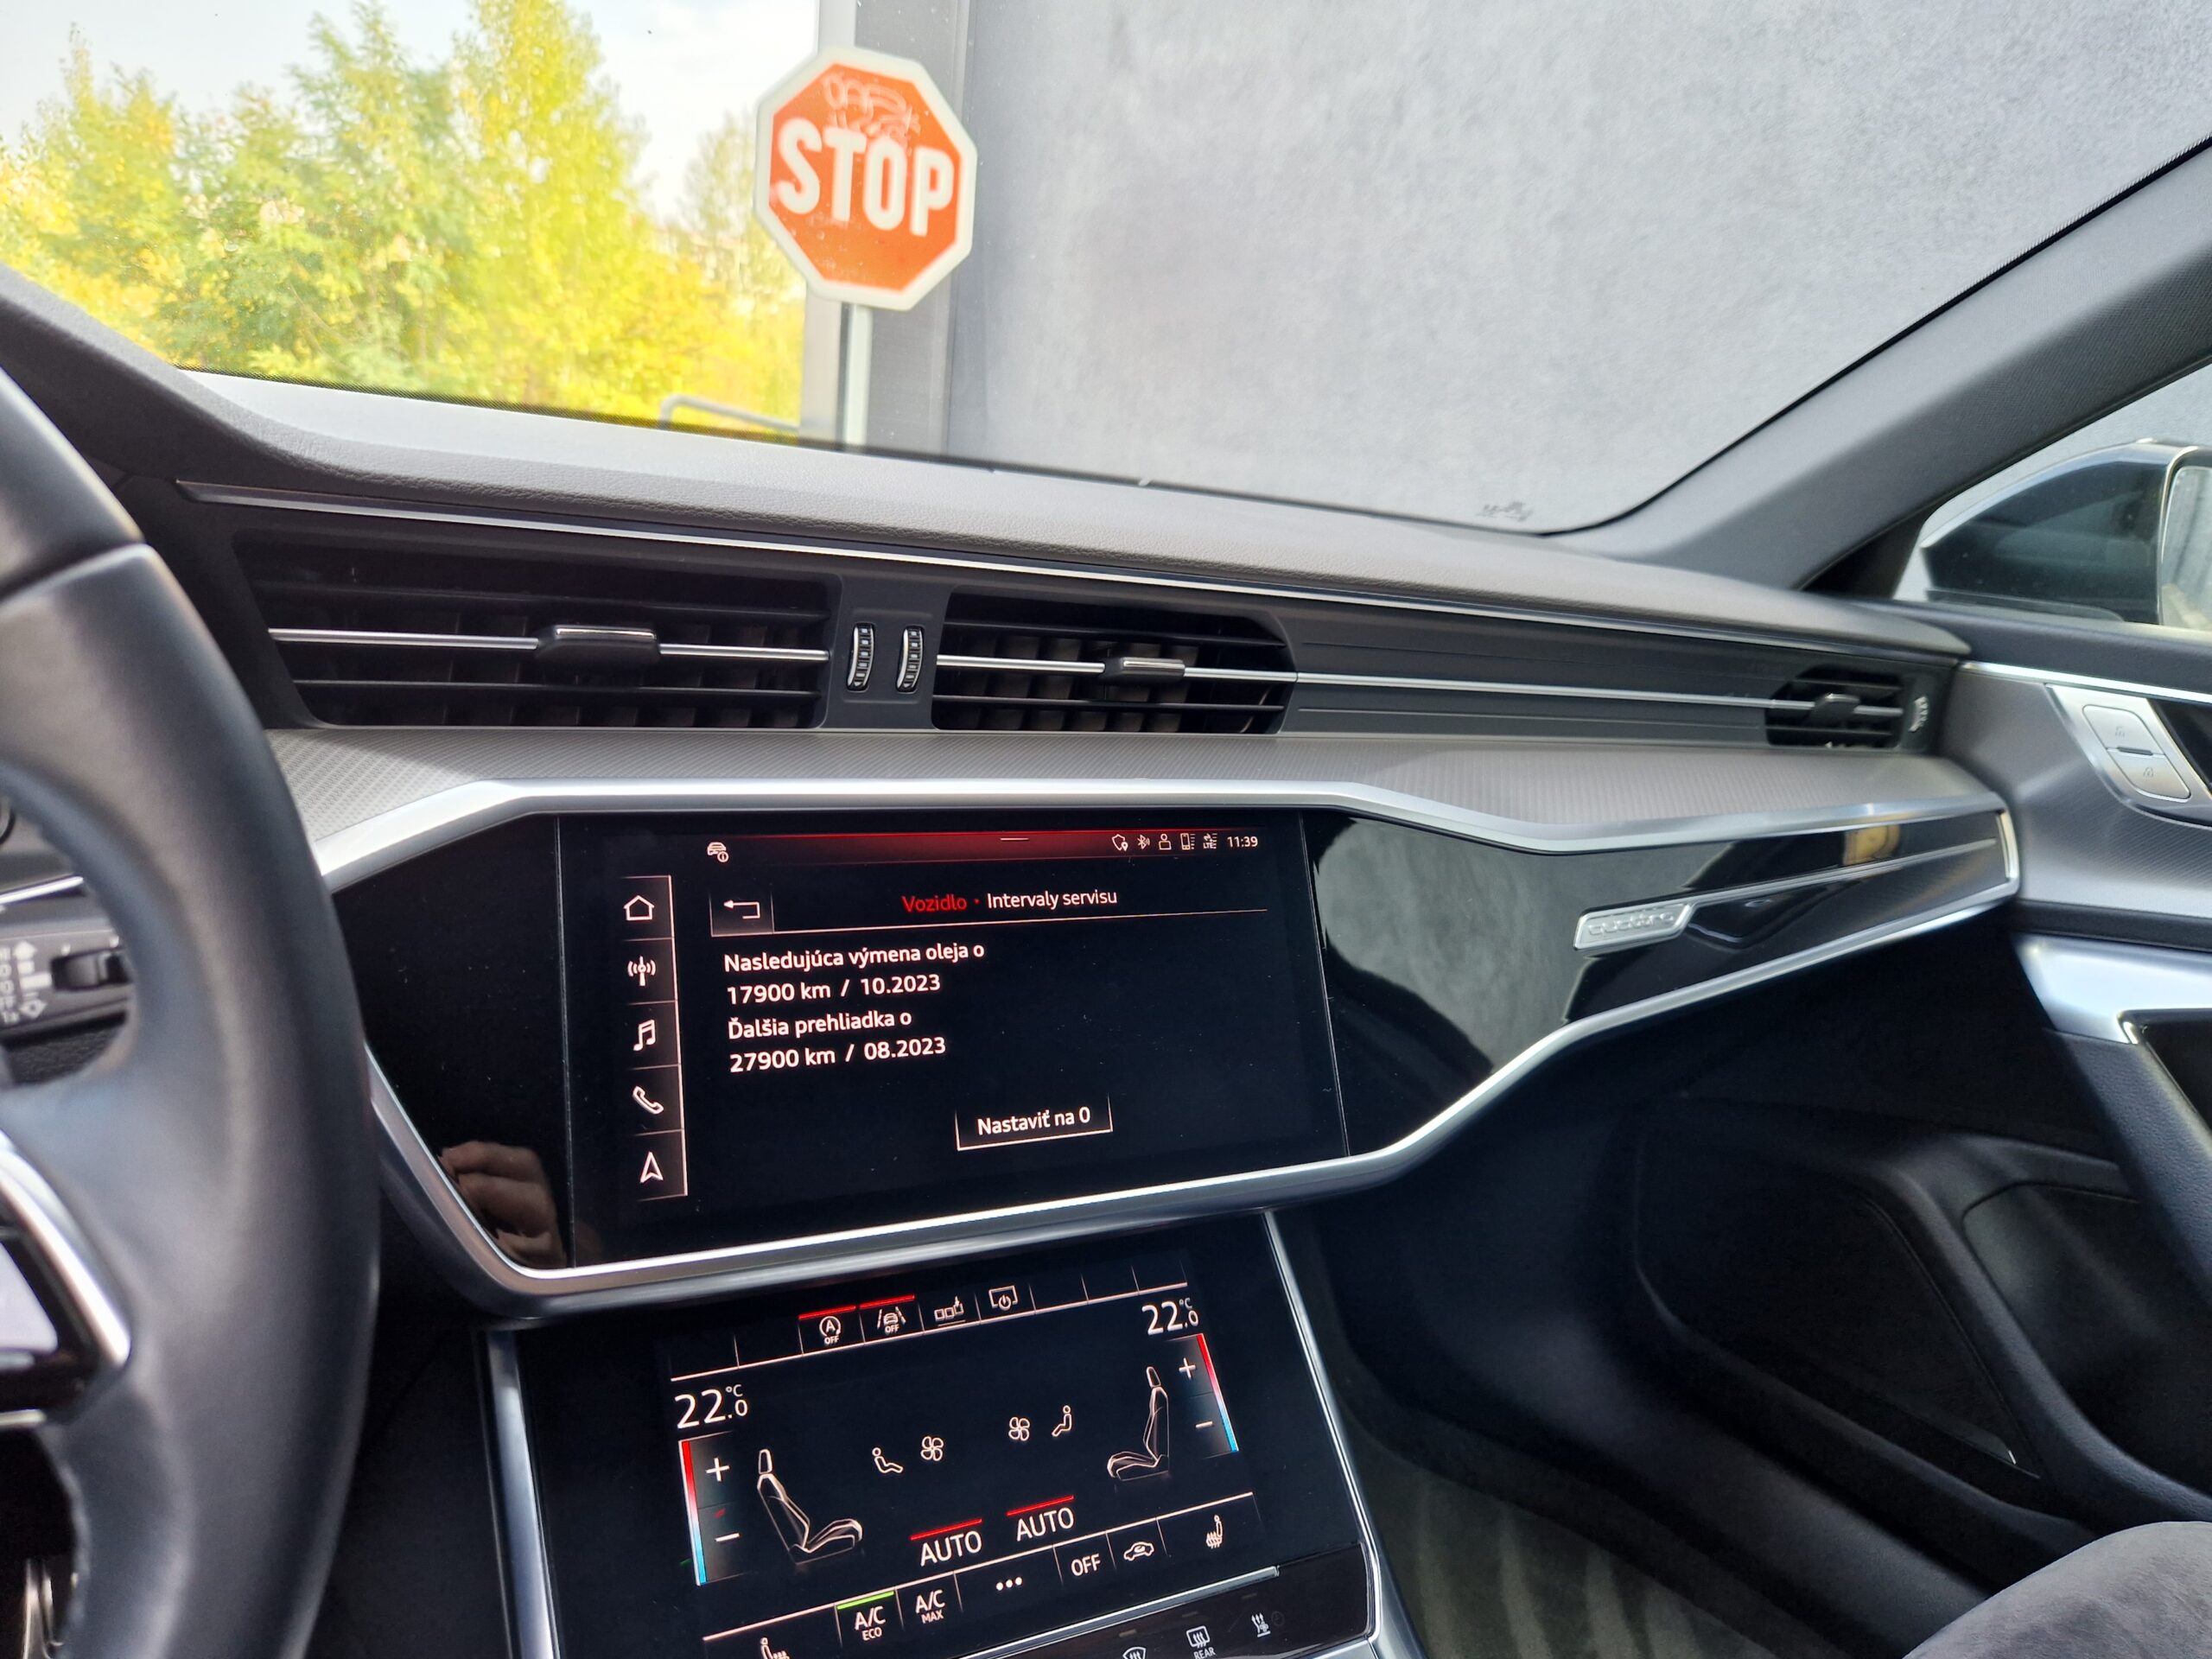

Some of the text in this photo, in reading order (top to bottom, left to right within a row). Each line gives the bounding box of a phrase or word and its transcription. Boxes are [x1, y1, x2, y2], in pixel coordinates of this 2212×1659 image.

[775, 116, 956, 238] STOP
[1227, 836, 1258, 848] 11:39
[902, 888, 1118, 913] Vozidlo Intervaly servisu
[724, 942, 985, 973] Nasledujúca výmena oleja o
[727, 973, 941, 1005] 17900 km / 10.2023
[728, 1010, 912, 1039] Ďalšia prehliadka o
[729, 1036, 946, 1073] 27900 km / 08.2023
[977, 1109, 1051, 1135] Nastaviť
[1054, 1112, 1075, 1127] na
[885, 1324, 899, 1333] OFF
[1141, 1300, 1199, 1335] 22.0
[824, 1335, 840, 1344] OFF
[674, 1388, 749, 1429] 22.0
[1015, 1506, 1075, 1542] AUTO
[919, 1529, 983, 1567] AUTO
[1071, 1553, 1101, 1577] OFF
[914, 1589, 946, 1614] A/C
[854, 1605, 887, 1631] A/C
[920, 1609, 944, 1624] MAX
[861, 1626, 883, 1642] ECO
[1193, 1647, 1216, 1659] REAR
